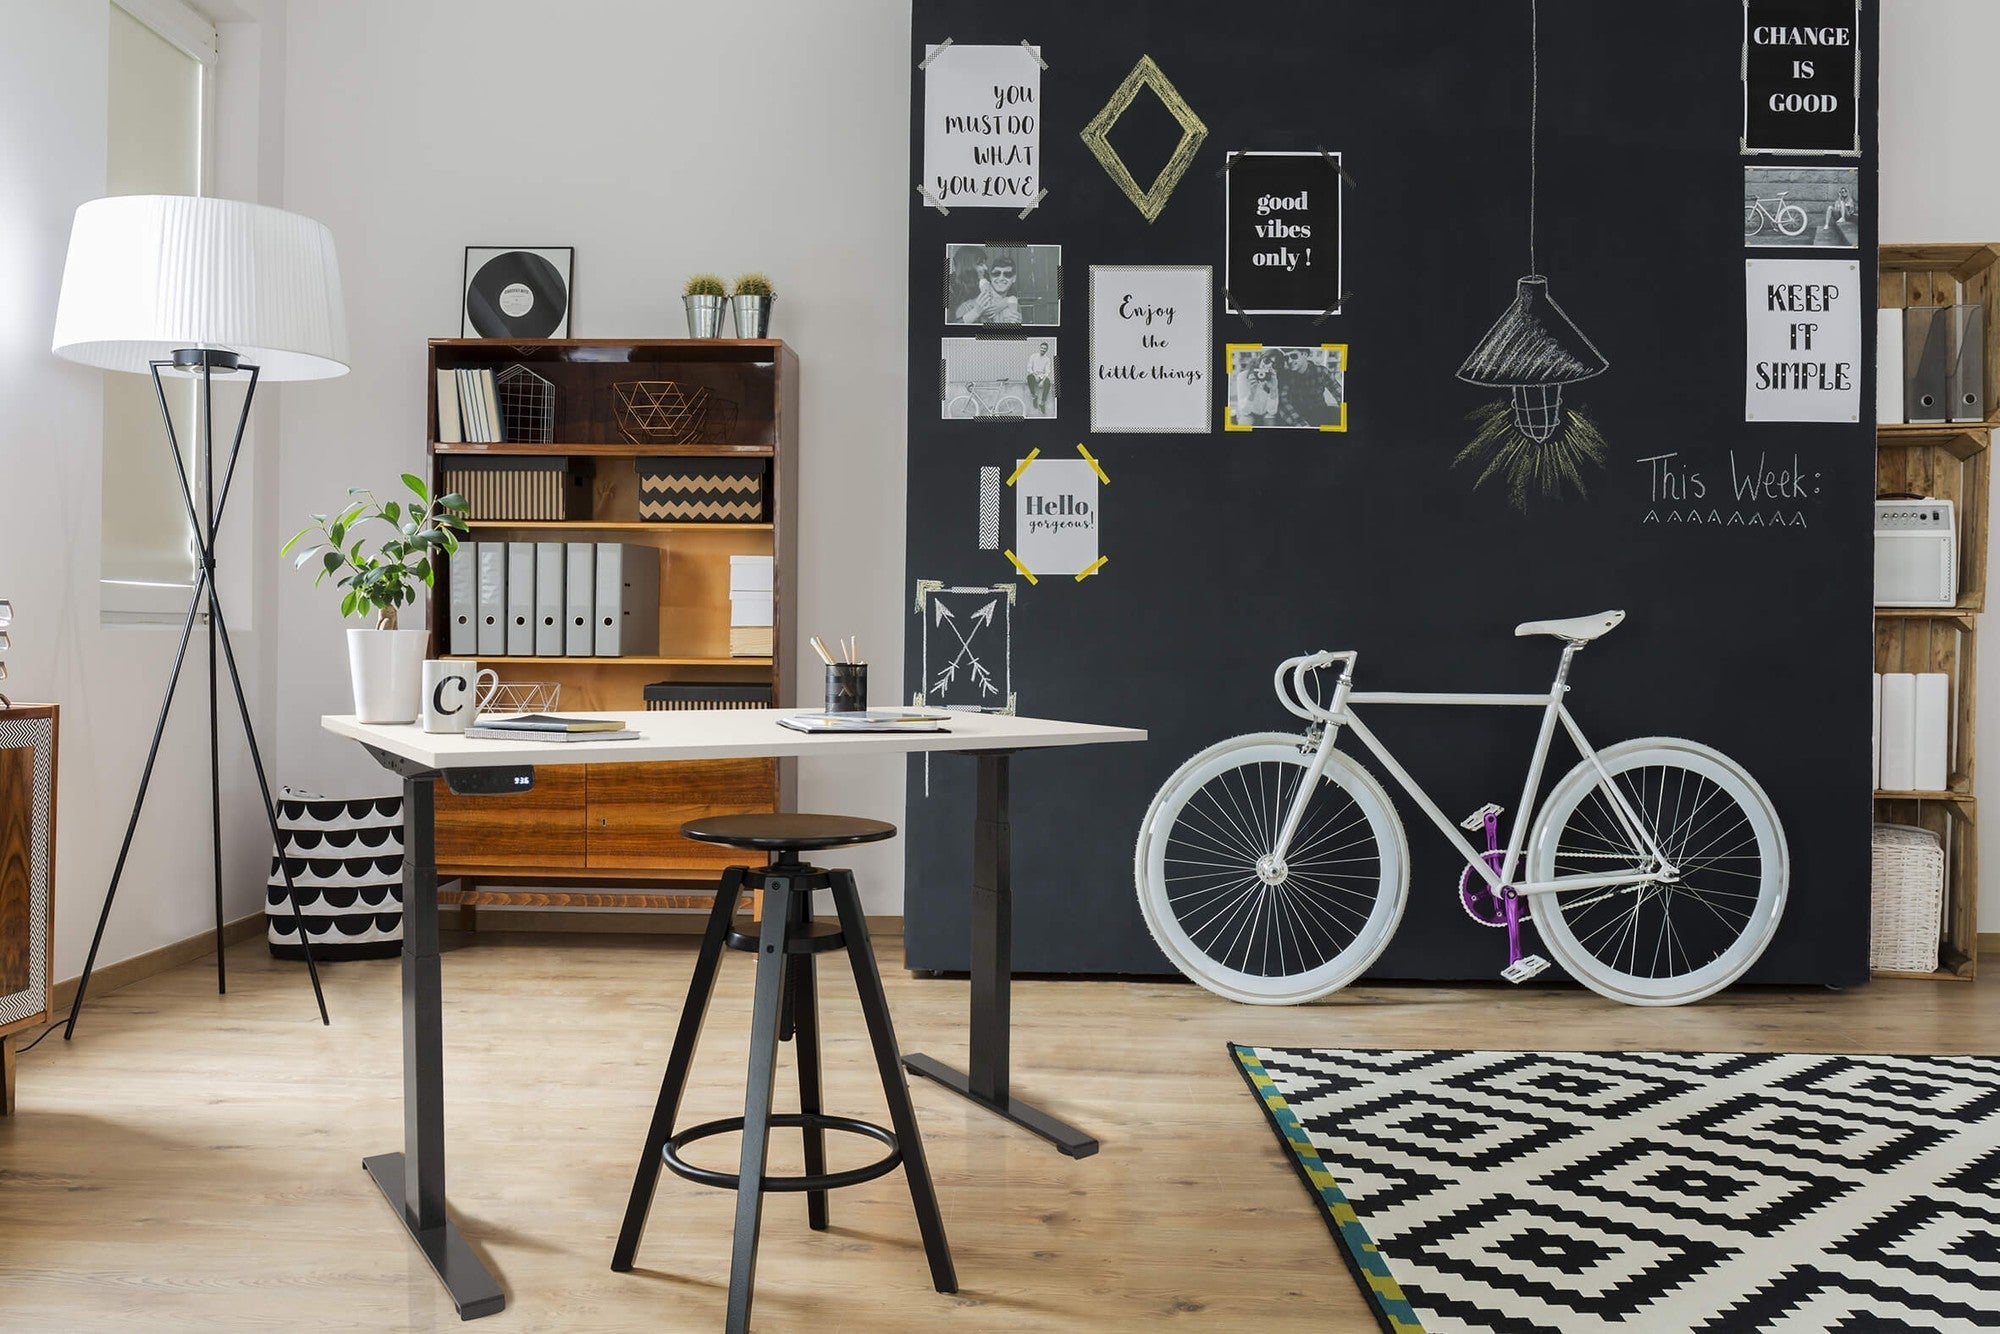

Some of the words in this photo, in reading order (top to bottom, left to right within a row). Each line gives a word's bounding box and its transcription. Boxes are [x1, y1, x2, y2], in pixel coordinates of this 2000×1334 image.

[1753, 26, 1850, 46] CHANGE
[1792, 60, 1815, 79] IS
[993, 85, 1034, 109] YOU
[1769, 93, 1838, 113] GOOD
[945, 114, 1002, 136] MUST
[1007, 115, 1035, 135] DO
[973, 144, 1033, 166] WHAT
[937, 175, 979, 200] YOU
[981, 175, 1034, 197] LOVE
[1256, 190, 1309, 216] good
[1255, 218, 1312, 240] vibes
[1252, 247, 1300, 272] only
[1118, 294, 1176, 325] Enjoy
[1767, 283, 1840, 313] KEEP
[1142, 334, 1169, 349] the
[1790, 323, 1819, 351] IT
[1098, 364, 1149, 380] little
[1151, 364, 1203, 386] things
[1755, 361, 1852, 391] SIMPLE
[1637, 452, 1706, 501] This
[1730, 449, 1822, 501] Week:
[1026, 494, 1089, 516] Hello
[1029, 511, 1095, 534] gorgeous!
[433, 675, 467, 716] C
